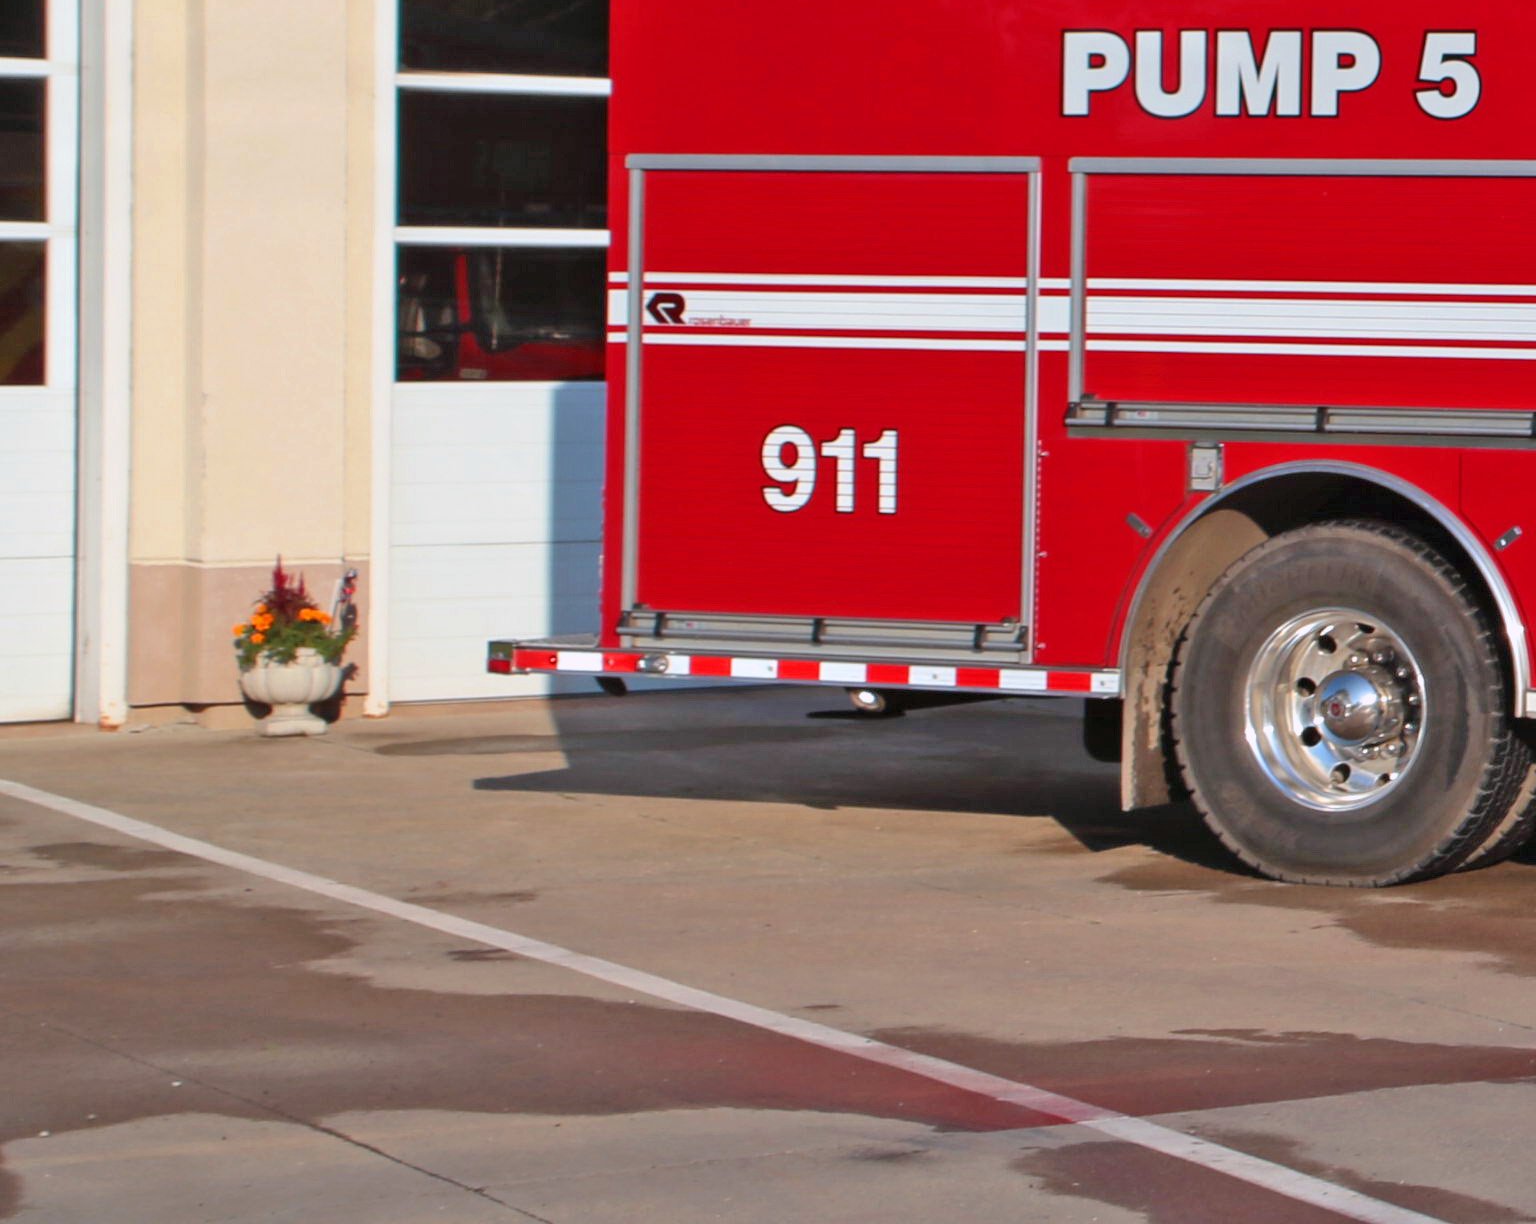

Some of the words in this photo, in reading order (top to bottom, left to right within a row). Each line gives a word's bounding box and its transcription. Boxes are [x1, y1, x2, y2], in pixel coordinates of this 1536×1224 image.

[1062, 29, 1381, 118] PUMP
[1415, 31, 1481, 120] 5
[760, 424, 899, 515] 911
